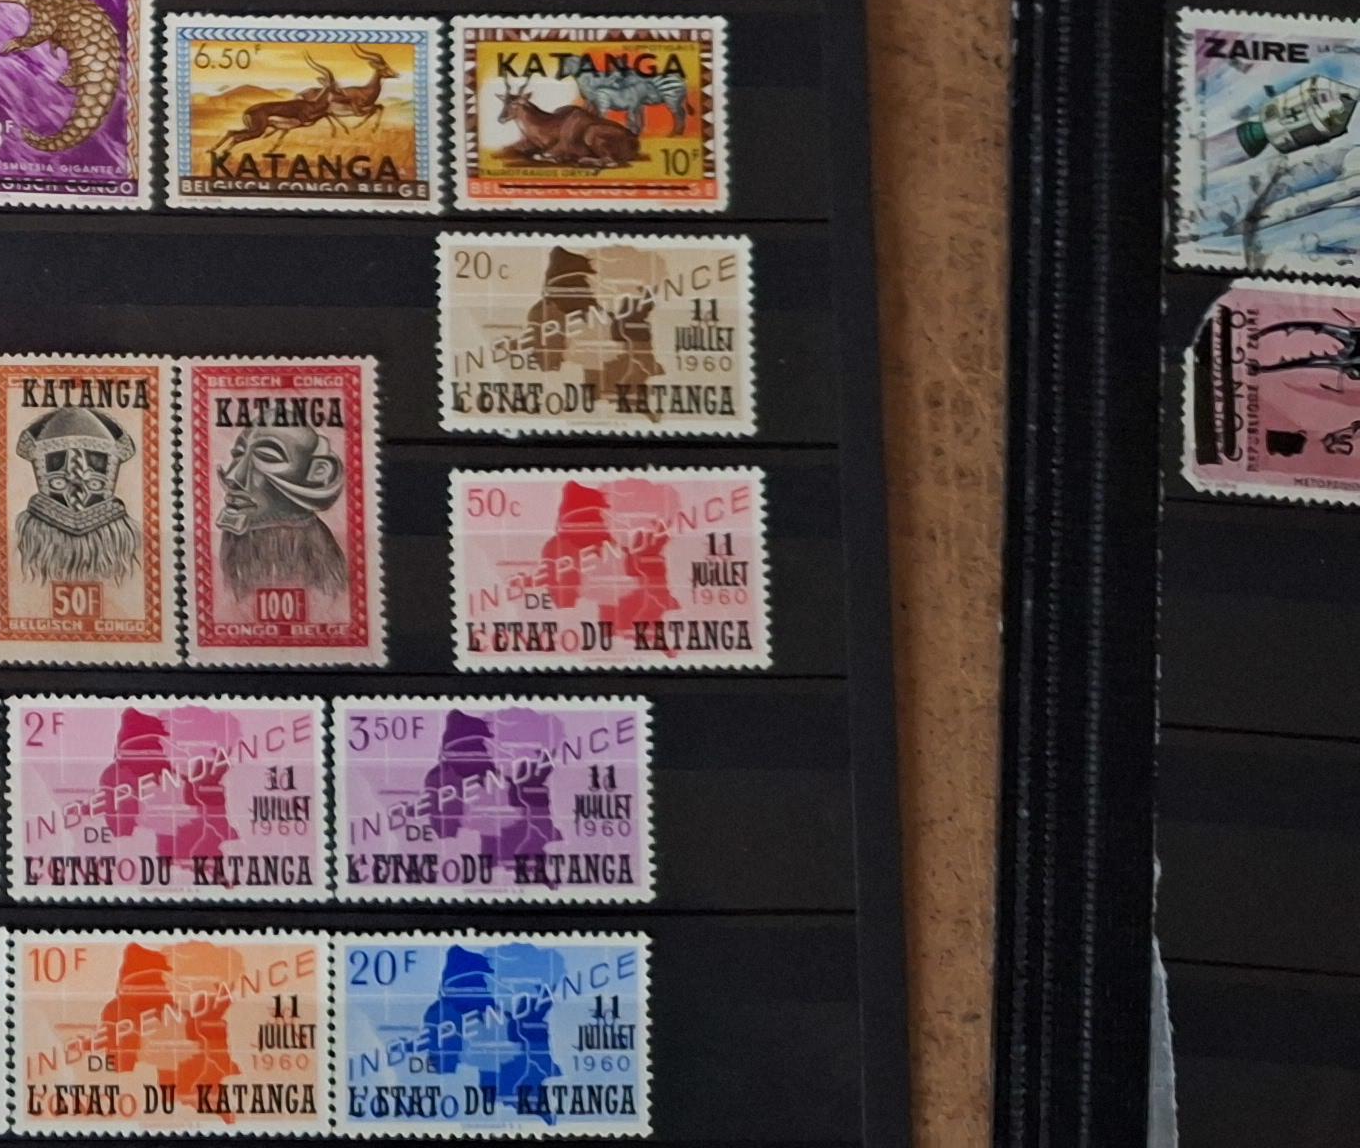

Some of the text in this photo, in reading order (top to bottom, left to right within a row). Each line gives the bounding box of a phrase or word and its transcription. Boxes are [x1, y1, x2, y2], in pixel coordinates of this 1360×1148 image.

[497, 52, 685, 79] KATANGA
[1202, 37, 1309, 64] ZAIRE
[210, 151, 405, 182] KATANGA
[676, 326, 734, 352] JUILLET
[676, 355, 733, 372] 1960
[21, 378, 149, 409] KATANGA
[563, 384, 735, 416] DU KATANGA
[215, 397, 344, 428] KATANGA
[692, 561, 749, 587] JUILLET
[582, 621, 613, 651] DU
[633, 620, 752, 651] KATANGA
[141, 853, 312, 887] DU KATANGA
[513, 854, 633, 886] KATANGA
[258, 1024, 316, 1052] JUILLET
[144, 1084, 175, 1114] DU
[196, 1082, 317, 1115] KATANGA
[516, 1084, 636, 1115] KATANGA
